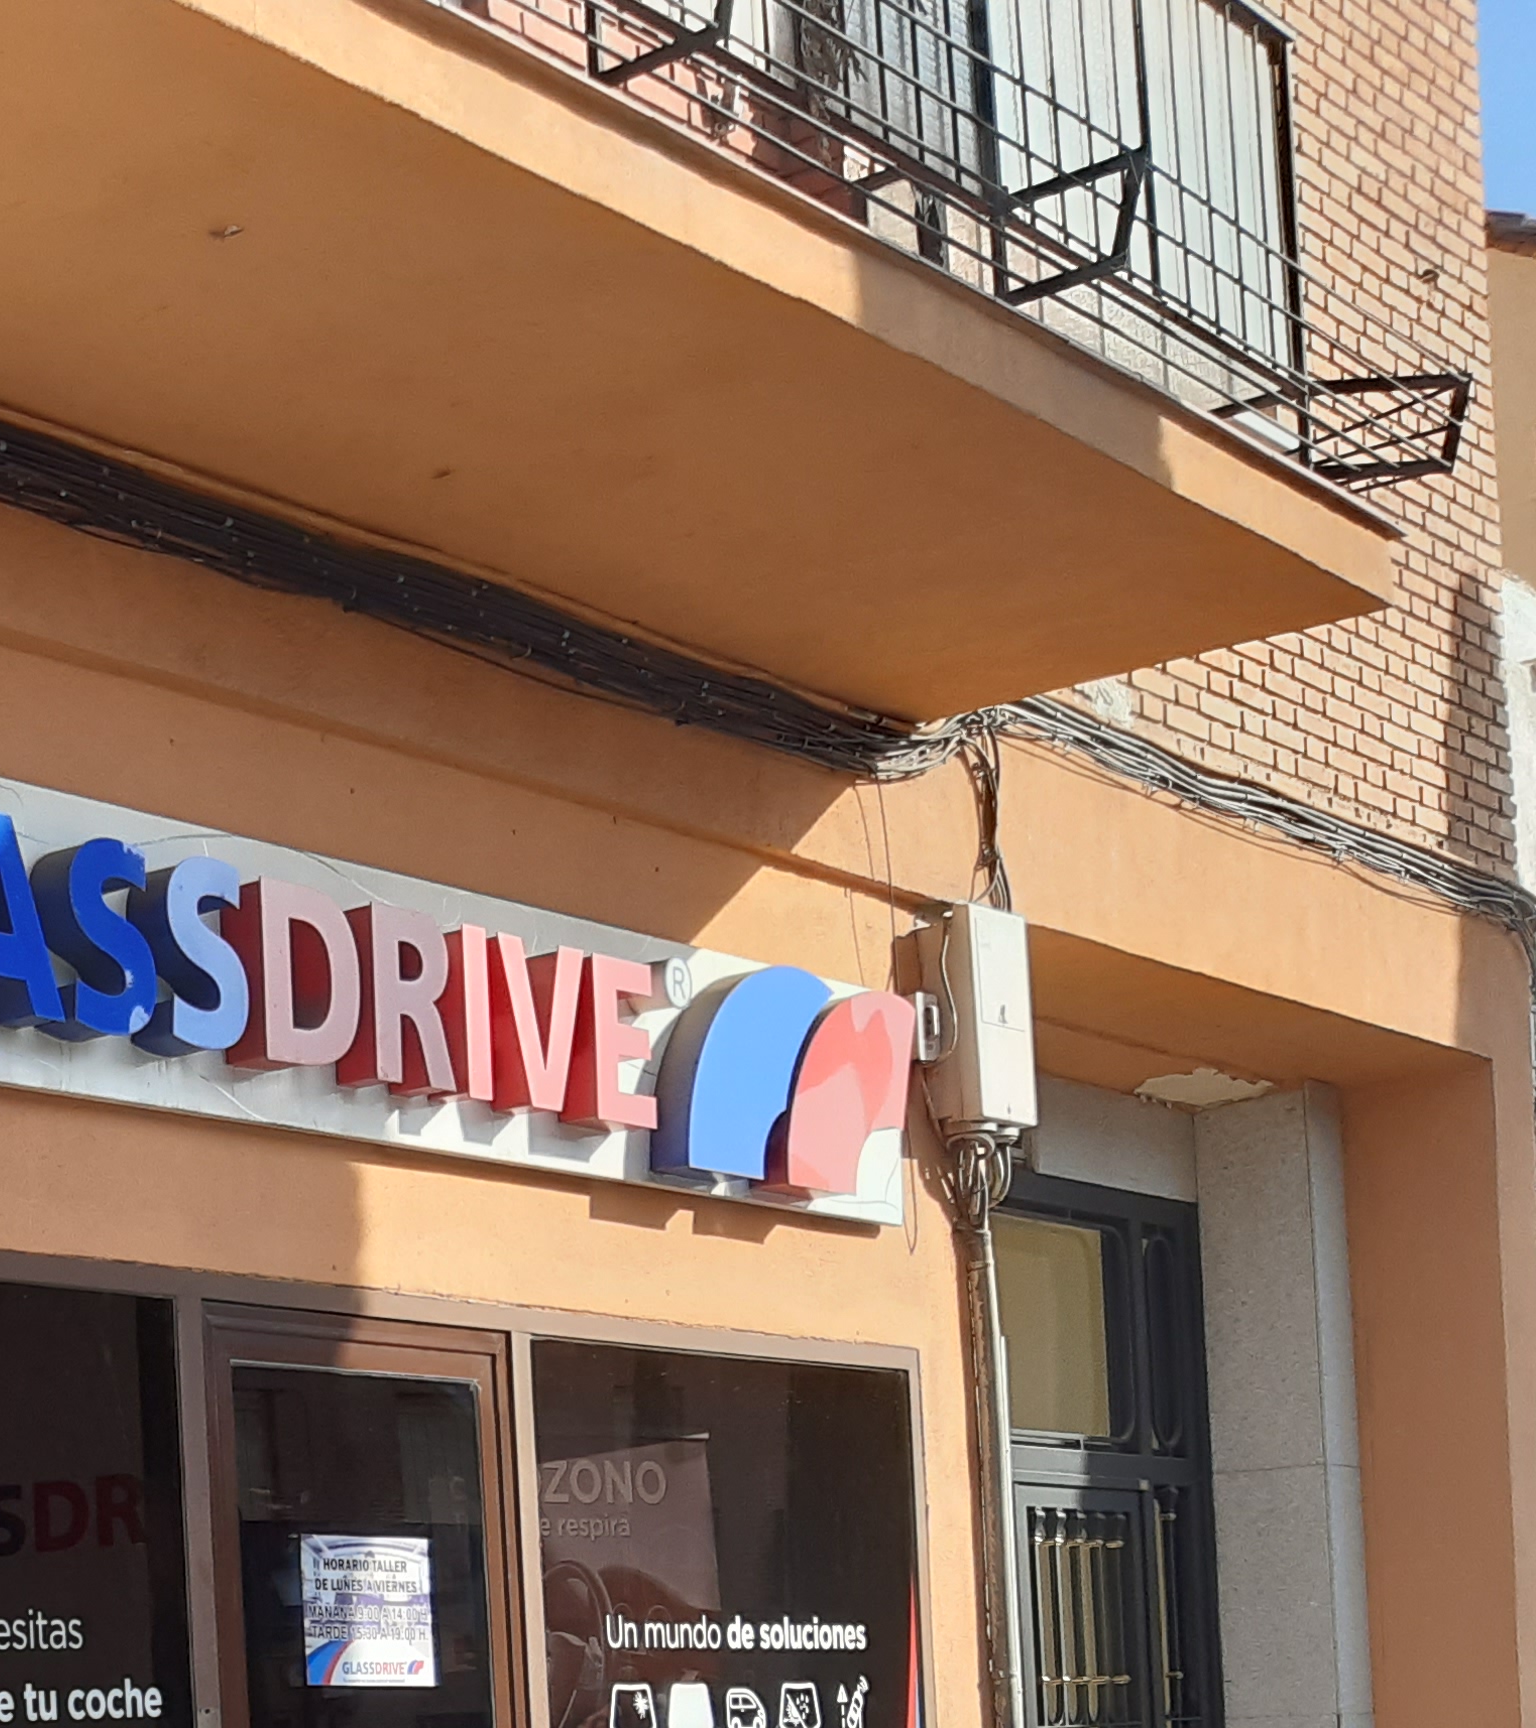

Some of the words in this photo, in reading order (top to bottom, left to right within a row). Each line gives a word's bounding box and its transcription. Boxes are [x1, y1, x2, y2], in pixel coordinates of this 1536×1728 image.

[537, 1460, 667, 1504] ZONO
[323, 1558, 369, 1571] HORARIO
[372, 1560, 408, 1573] TALLER
[315, 1579, 329, 1591] DE
[331, 1579, 364, 1592] LUNES
[375, 1580, 418, 1593] VIERNES
[311, 1626, 347, 1640] TARDE
[605, 1613, 639, 1650] Un
[644, 1616, 722, 1650] mundo
[727, 1616, 754, 1650] de
[759, 1615, 868, 1650] soluciones
[342, 1661, 405, 1675] GLASSDRIVE
[24, 1683, 58, 1721] tu
[67, 1678, 163, 1721] coche
